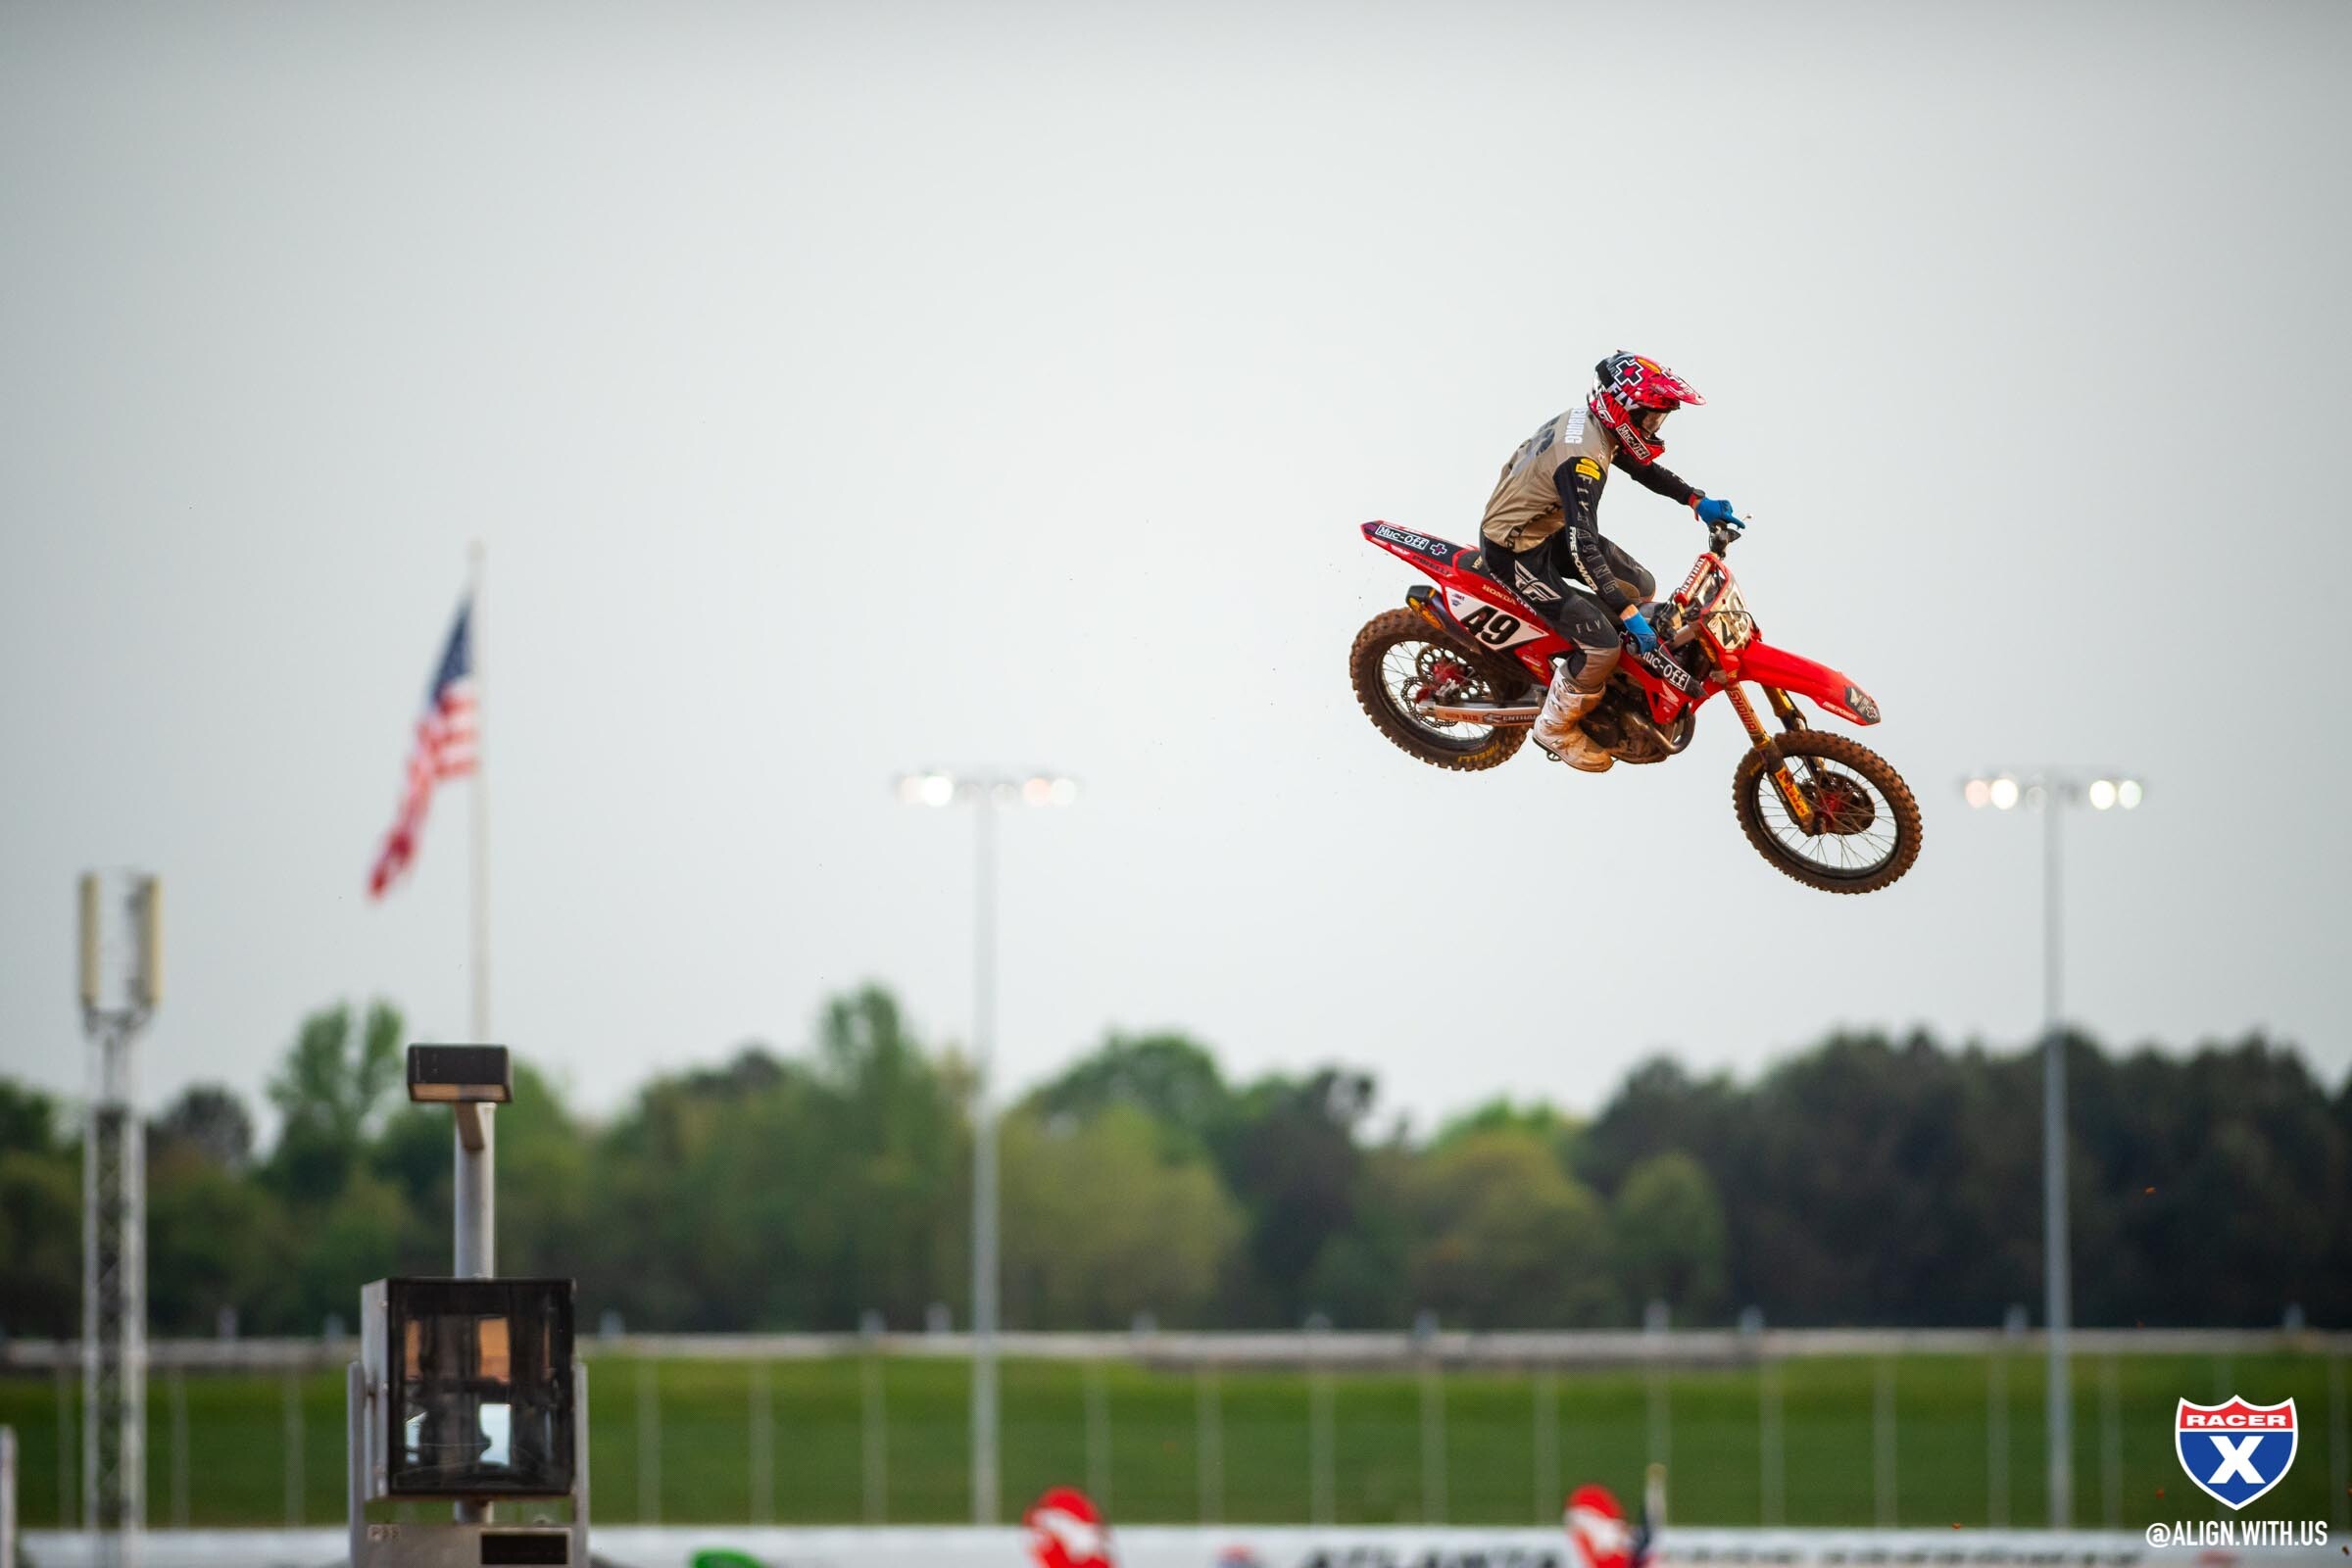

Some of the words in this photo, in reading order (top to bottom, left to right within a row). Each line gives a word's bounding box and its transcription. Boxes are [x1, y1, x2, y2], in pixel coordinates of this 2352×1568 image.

[1607, 381, 1640, 411] FLY
[1378, 526, 1428, 549] Muc-Off
[1482, 584, 1517, 606] HONDA
[1460, 606, 1521, 645] 49
[1576, 619, 1601, 634] FLY
[1729, 689, 1757, 732] SHOWA
